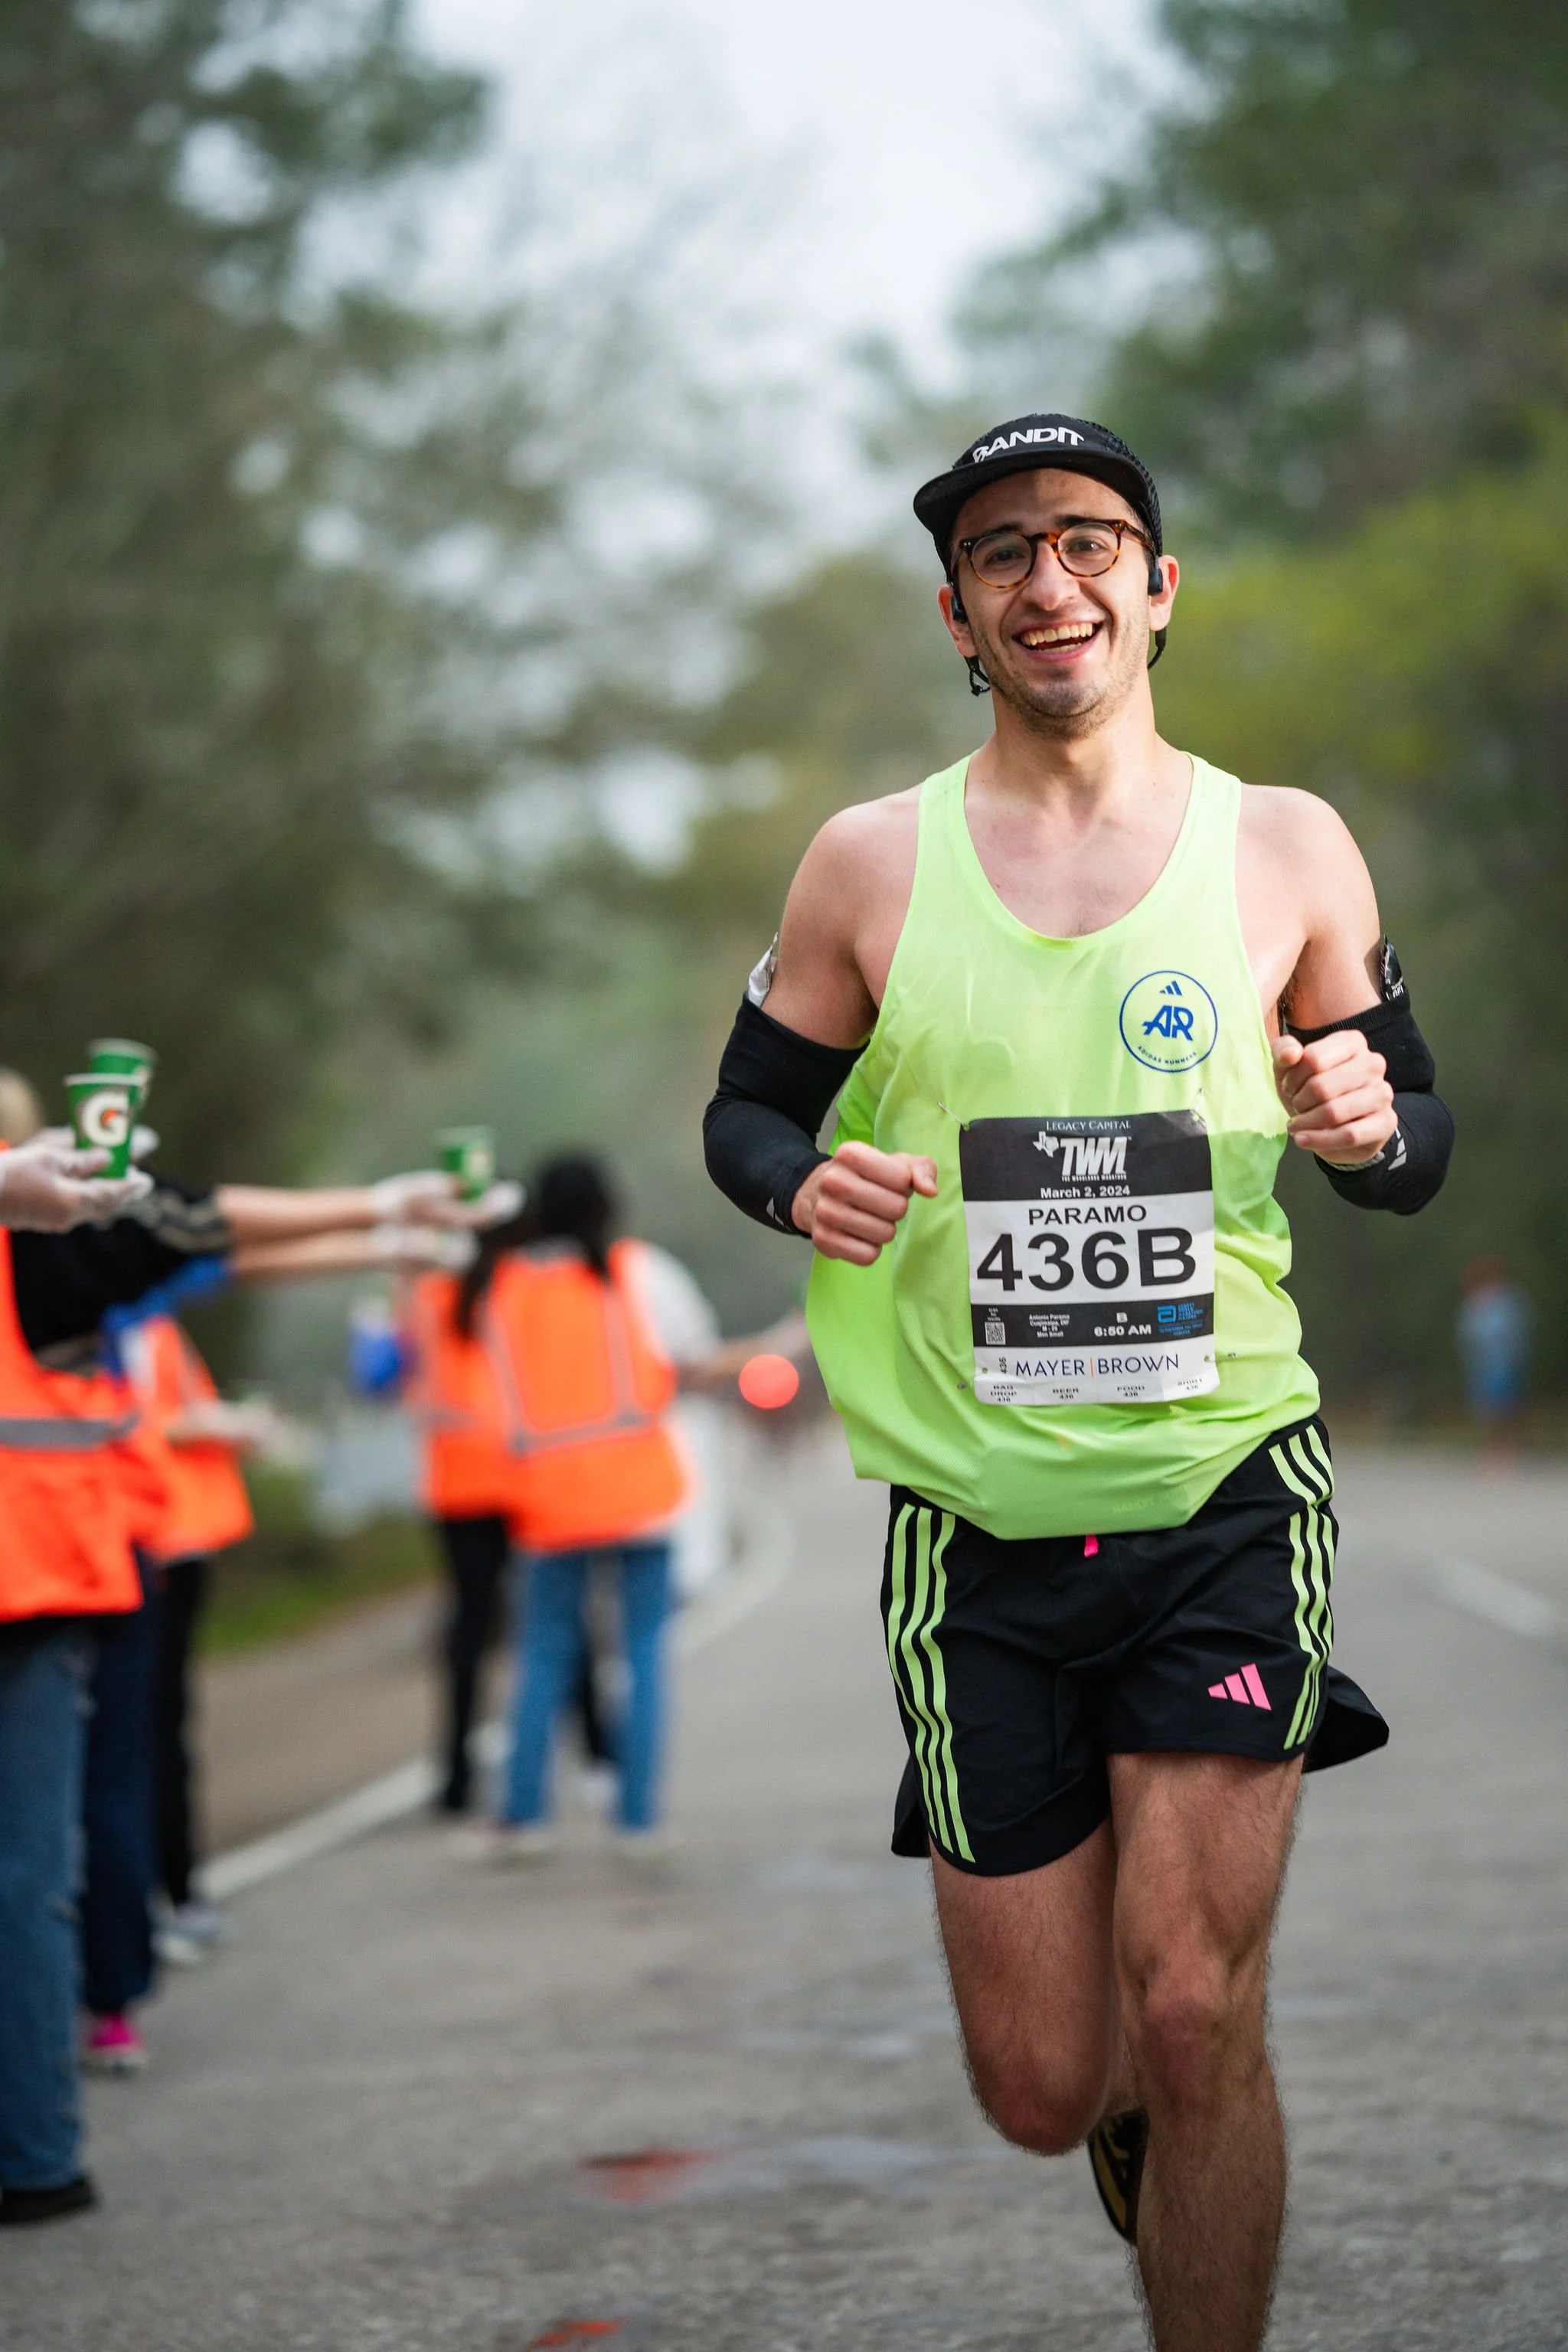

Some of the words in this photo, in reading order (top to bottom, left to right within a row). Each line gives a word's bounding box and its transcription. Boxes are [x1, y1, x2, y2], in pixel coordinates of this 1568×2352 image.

[972, 426, 1084, 463] BANDIT
[1142, 1004, 1194, 1041] AR
[81, 1090, 129, 1147] G
[1060, 1136, 1127, 1176] TWM
[1040, 1187, 1080, 1199] March
[1084, 1186, 1096, 1199] 2,
[1099, 1185, 1131, 1197] 2024
[1028, 1204, 1147, 1225] PARAMO
[977, 1227, 1196, 1292] 436B
[1094, 1325, 1125, 1337] 6:50
[1128, 1324, 1152, 1335] AM
[999, 1357, 1008, 1374] 436
[1016, 1359, 1085, 1377] MAYER
[1098, 1354, 1179, 1374] BROWN
